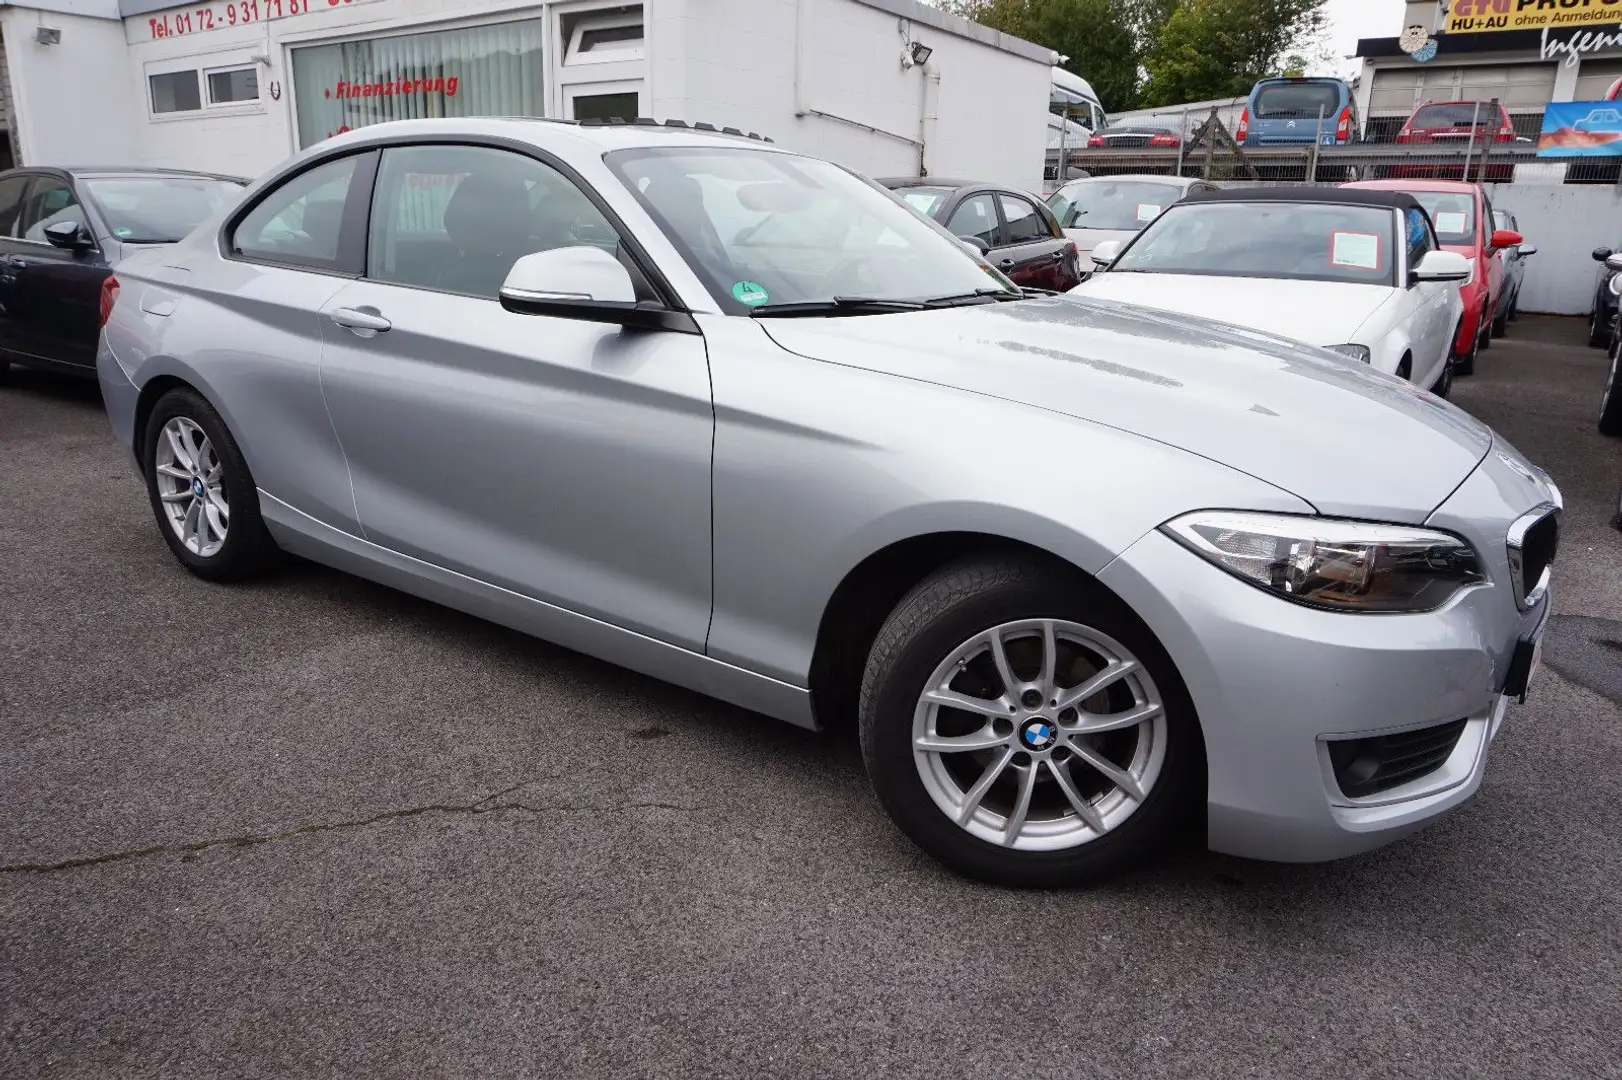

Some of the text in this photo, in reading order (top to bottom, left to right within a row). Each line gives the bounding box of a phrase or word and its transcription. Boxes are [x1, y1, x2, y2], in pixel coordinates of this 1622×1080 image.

[149, 15, 173, 38] Tel.
[1451, 15, 1508, 30] HU+AU
[1515, 15, 1547, 26] ohne
[335, 77, 458, 99] Finanzierung
